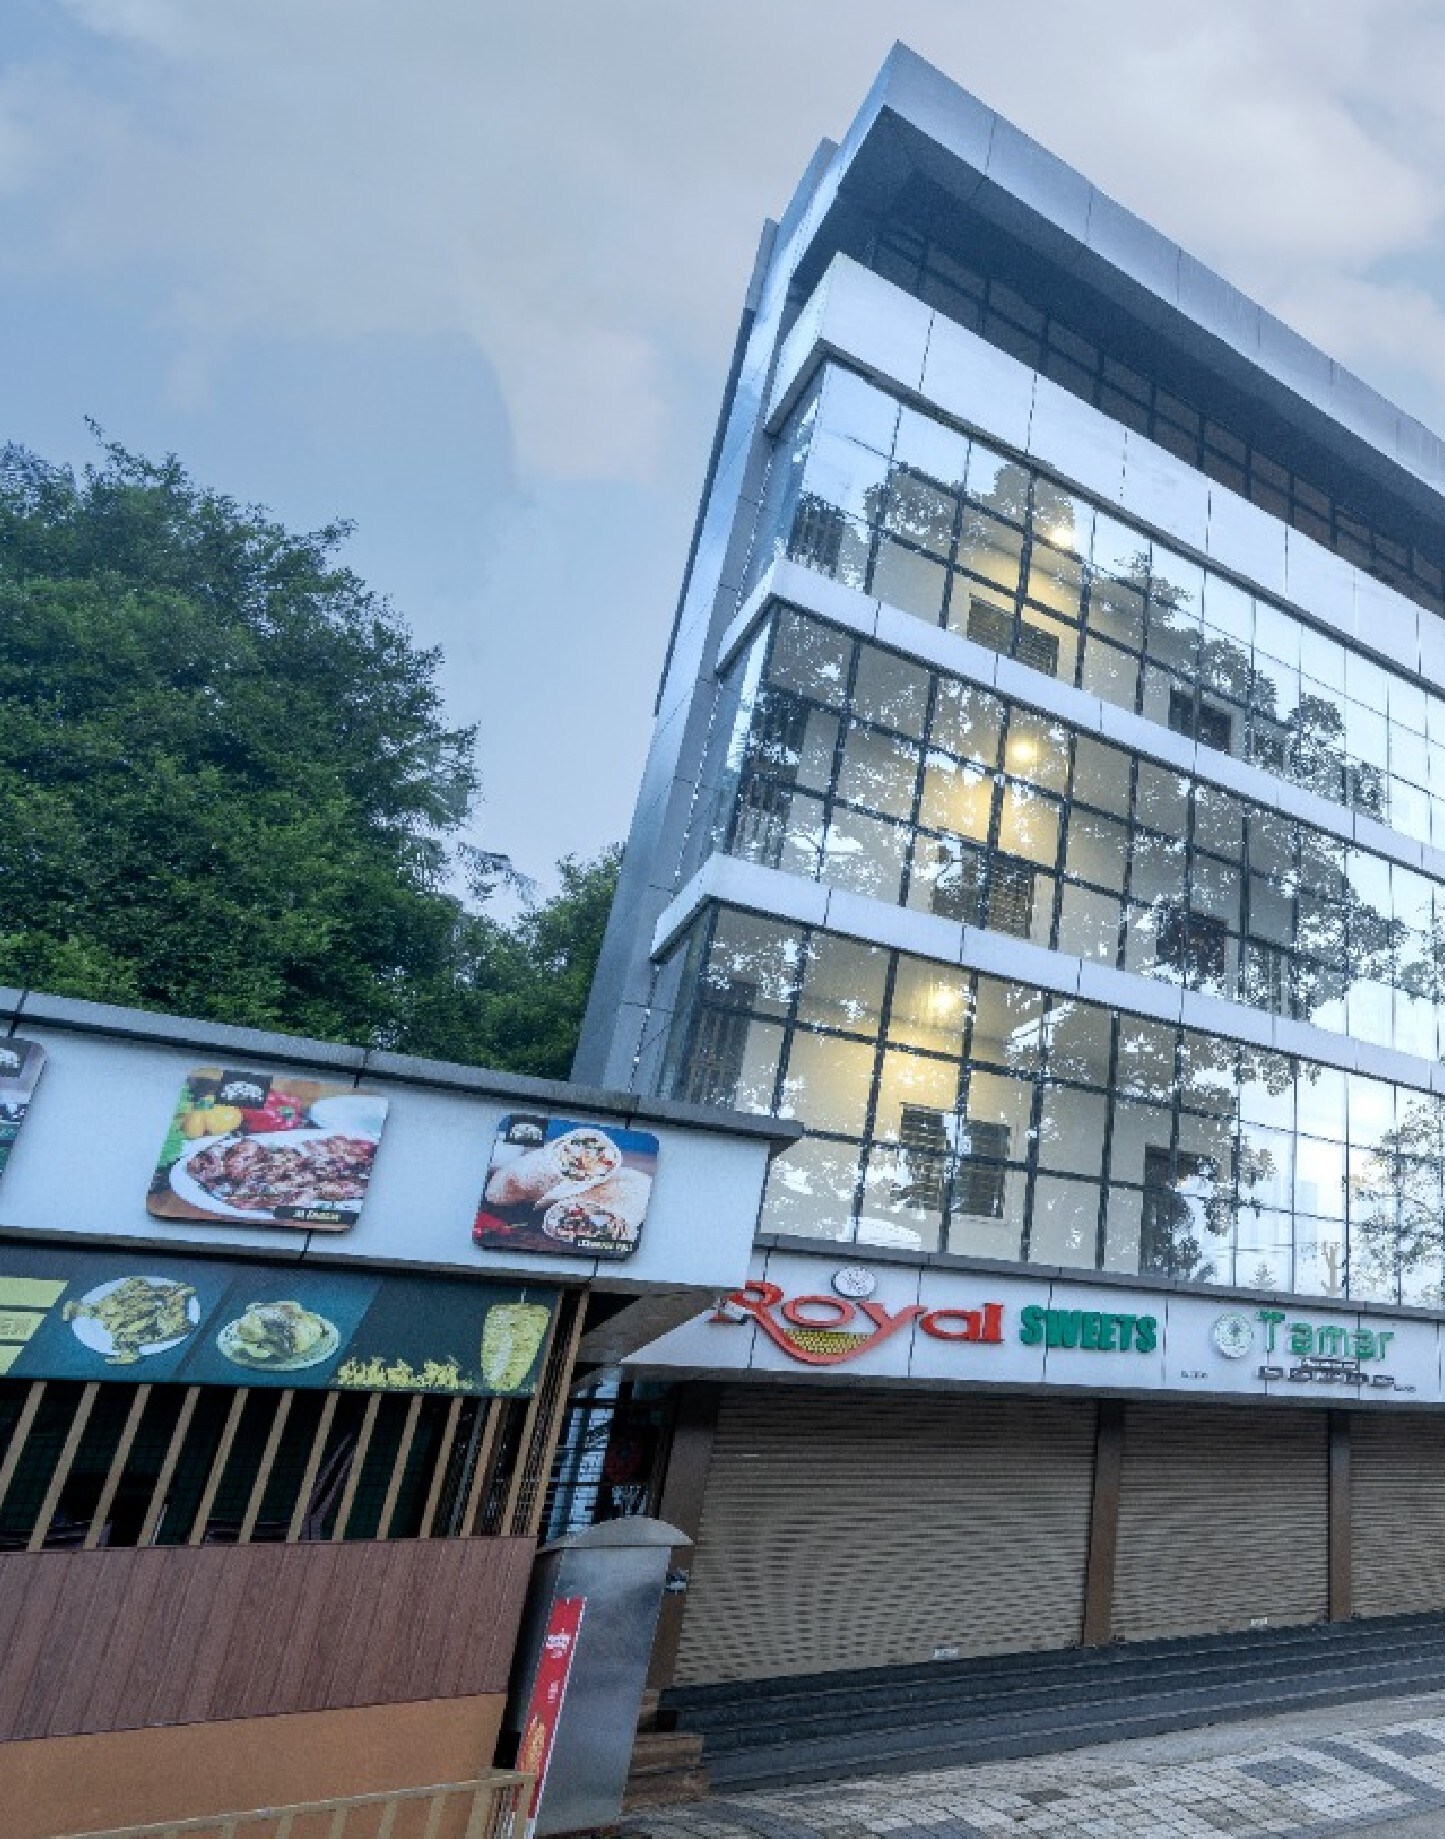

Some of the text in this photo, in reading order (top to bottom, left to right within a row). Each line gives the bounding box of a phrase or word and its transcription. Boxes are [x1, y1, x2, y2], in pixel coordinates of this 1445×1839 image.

[709, 1280, 1157, 1366] Royal SWEETS
[1256, 1310, 1395, 1361] Tamar
